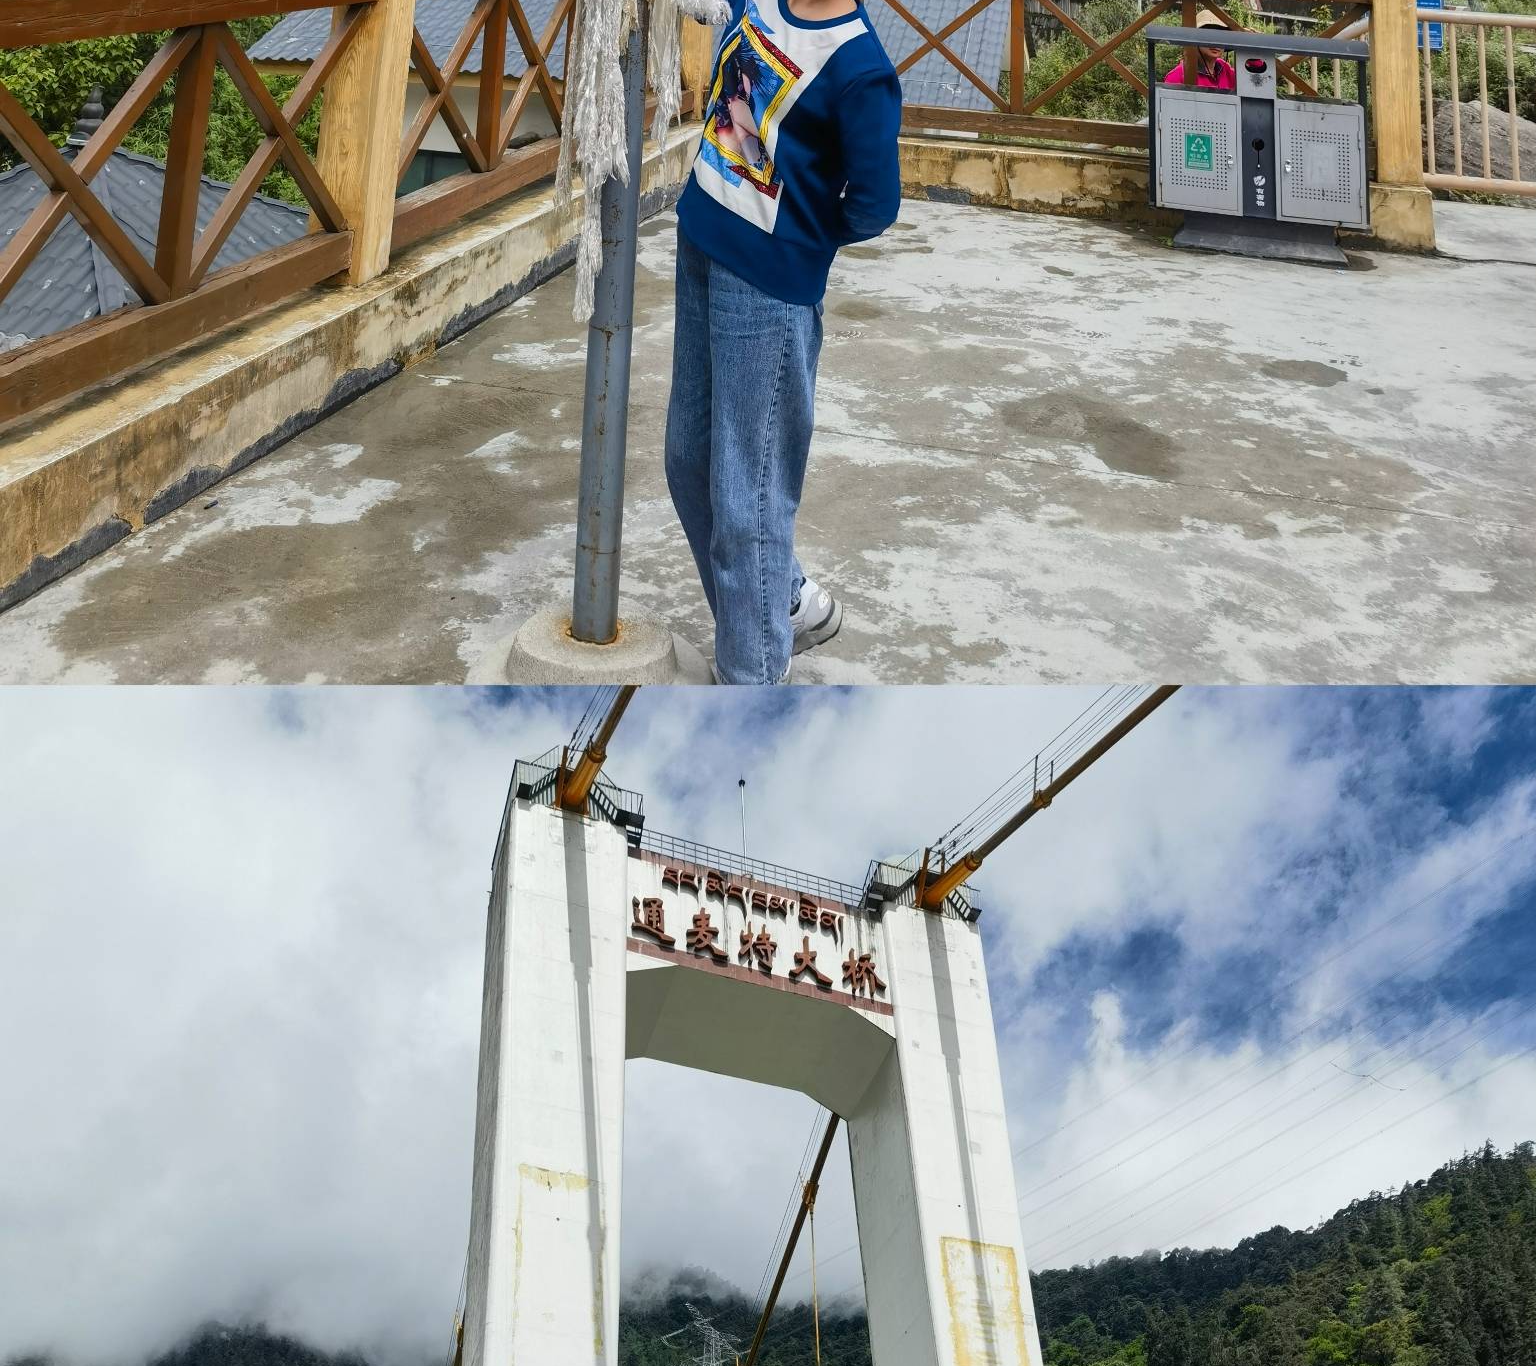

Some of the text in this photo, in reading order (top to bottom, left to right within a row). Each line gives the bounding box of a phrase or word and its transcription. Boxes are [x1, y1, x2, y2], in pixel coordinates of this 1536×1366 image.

[631, 896, 887, 999] 通麦特大桥
